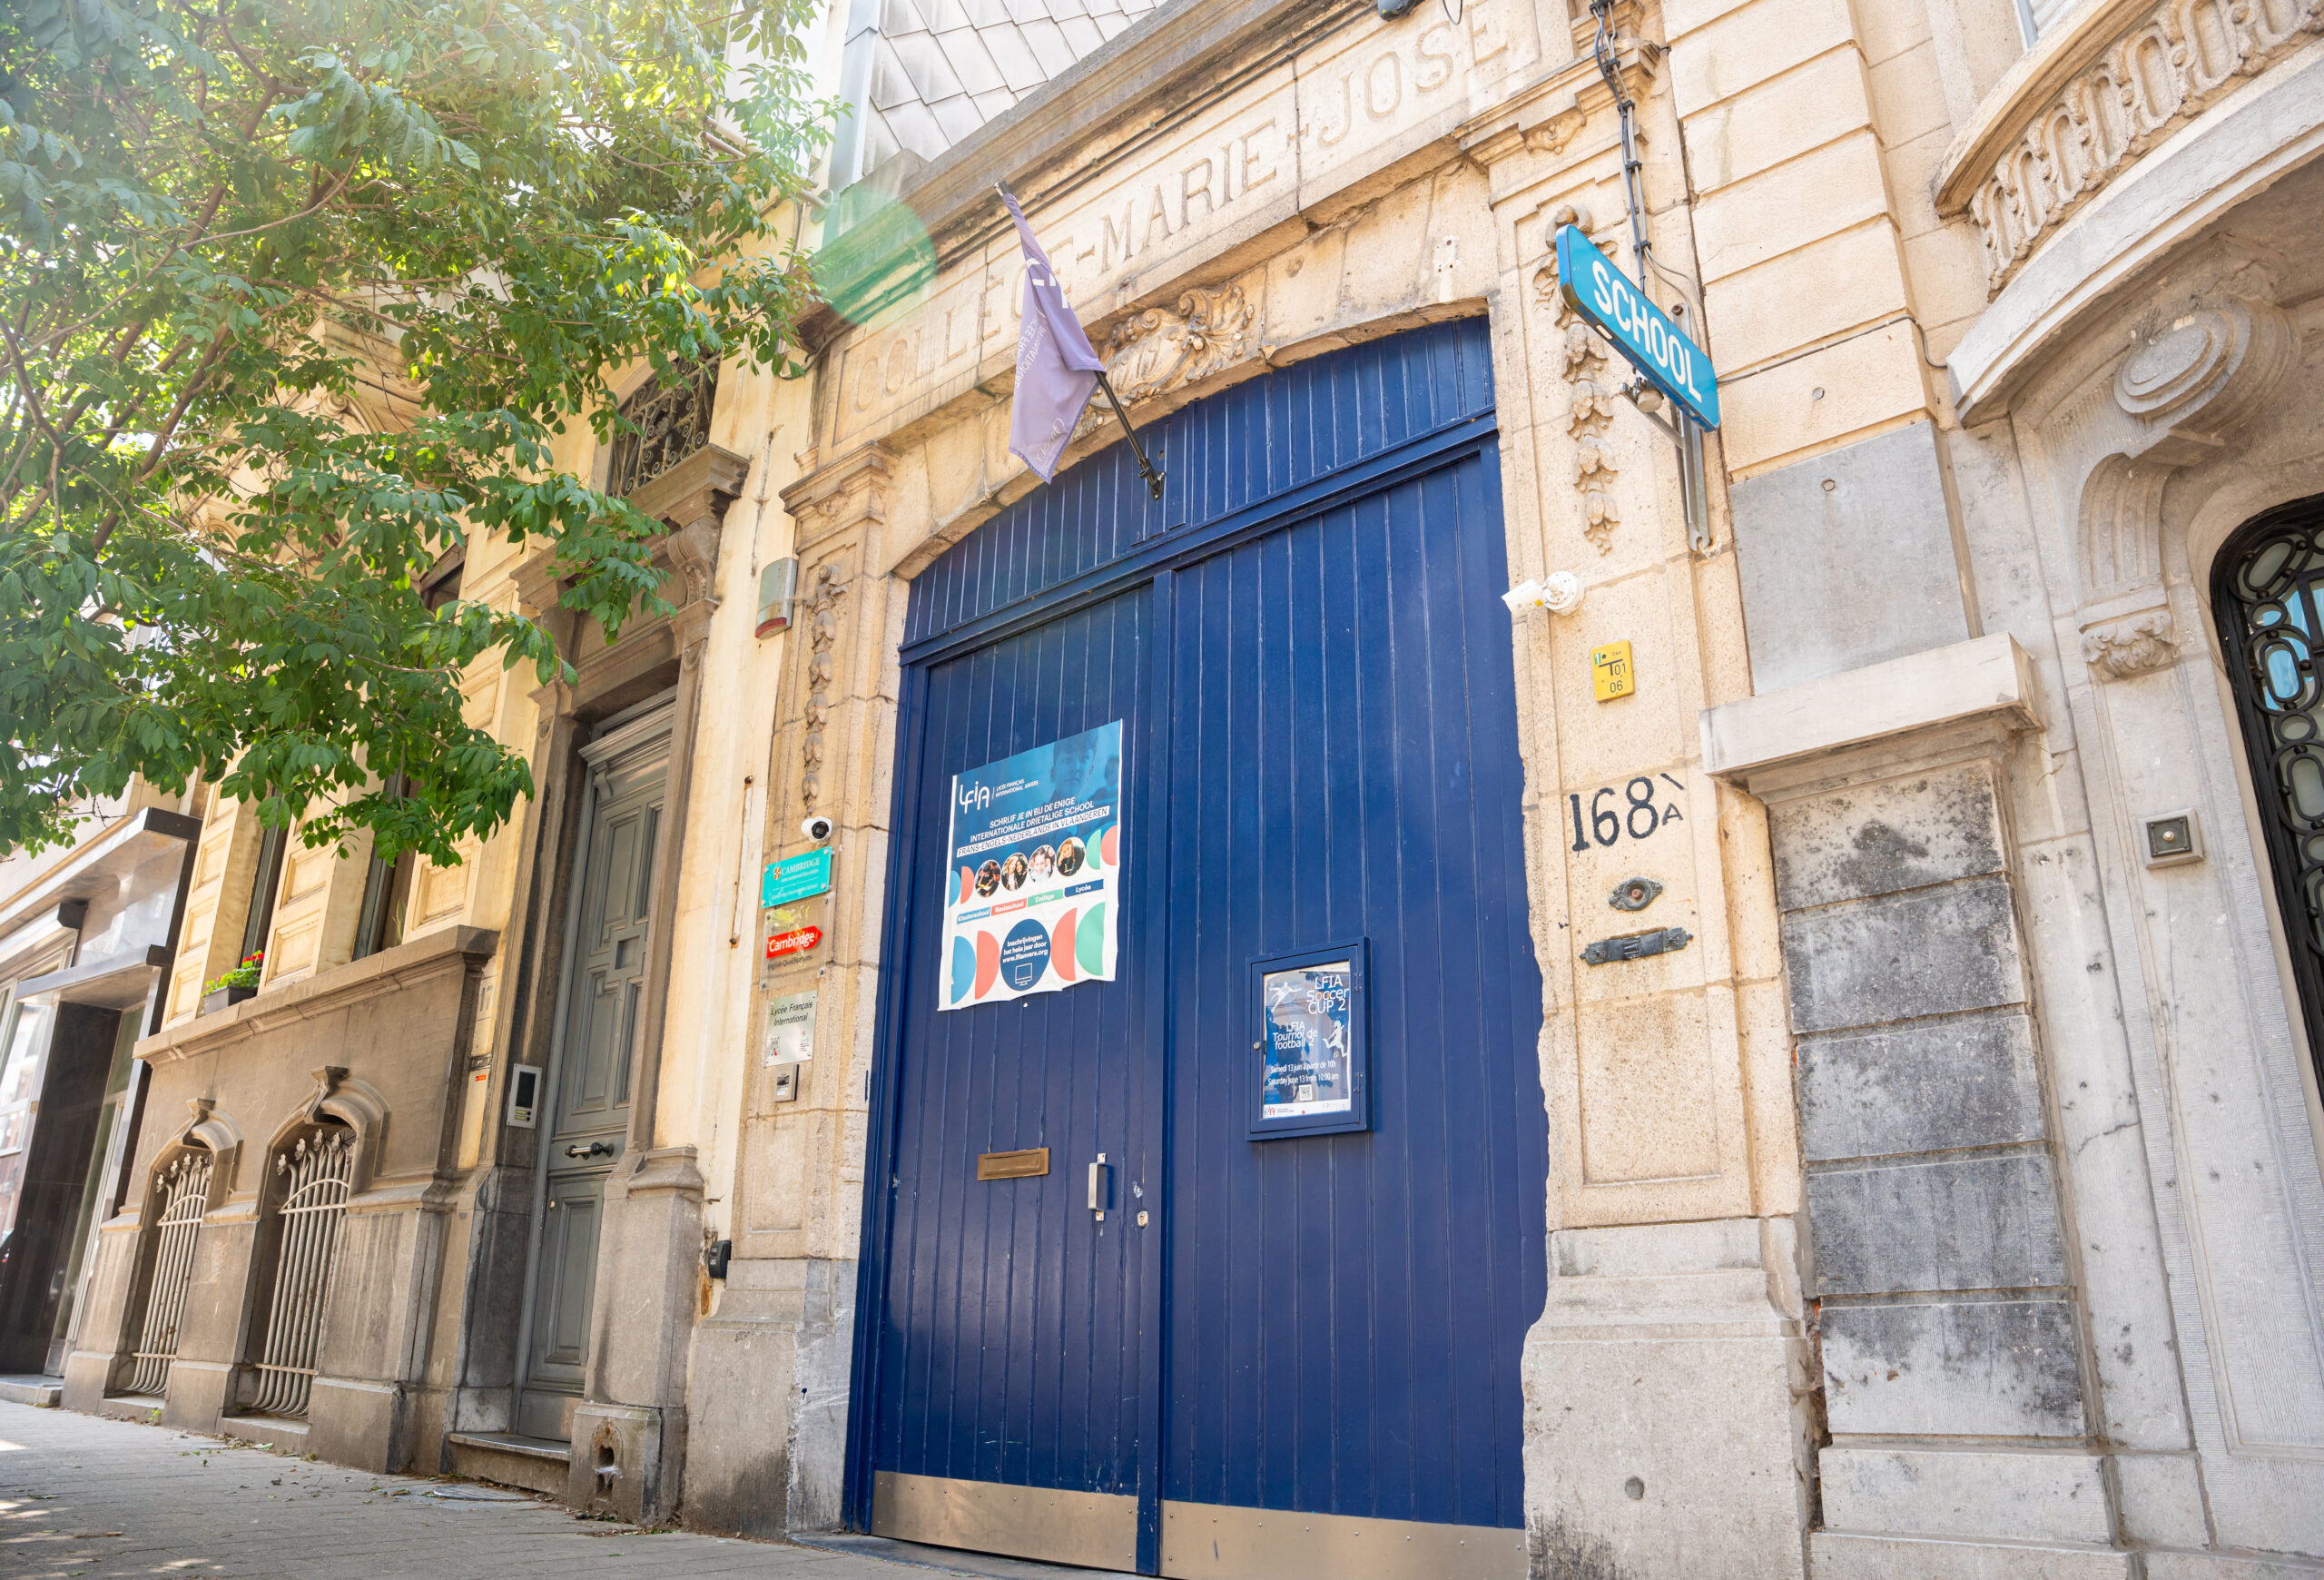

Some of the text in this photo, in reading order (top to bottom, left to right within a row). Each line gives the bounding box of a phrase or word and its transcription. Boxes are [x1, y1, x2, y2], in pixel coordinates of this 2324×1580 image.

[1592, 260, 1702, 403] SCHOOL
[1610, 680, 1623, 693] 06
[990, 796, 1076, 828] SCHRIJF JE IN BIJ DE ENIGE
[970, 801, 1094, 843] INTERNATIONALE DRIETALIGE SCHOOL
[958, 807, 1108, 856] FRANS-ENGELS-NEDERLANDS IN VLAANDEREN
[781, 856, 821, 876] CAMBRIDGE
[769, 931, 815, 952] Cambridge
[1007, 934, 1043, 947] Inschrijvingen
[1003, 948, 1012, 956] het
[1023, 943, 1034, 953] jaar
[1033, 941, 1048, 949] door
[1315, 974, 1344, 990] LFIA
[1306, 988, 1350, 1002] Soccer
[770, 1001, 813, 1016] Lycée Français
[1308, 998, 1346, 1014] CUP 2
[774, 1012, 809, 1026] International
[1285, 1021, 1305, 1032] LFIA
[1273, 1028, 1318, 1042] Tournoi de
[1275, 1037, 1315, 1051] football 2
[1288, 1063, 1294, 1071] 13
[1294, 1063, 1303, 1072] juin
[1319, 1060, 1327, 1069] de
[1299, 1074, 1305, 1082] 13
